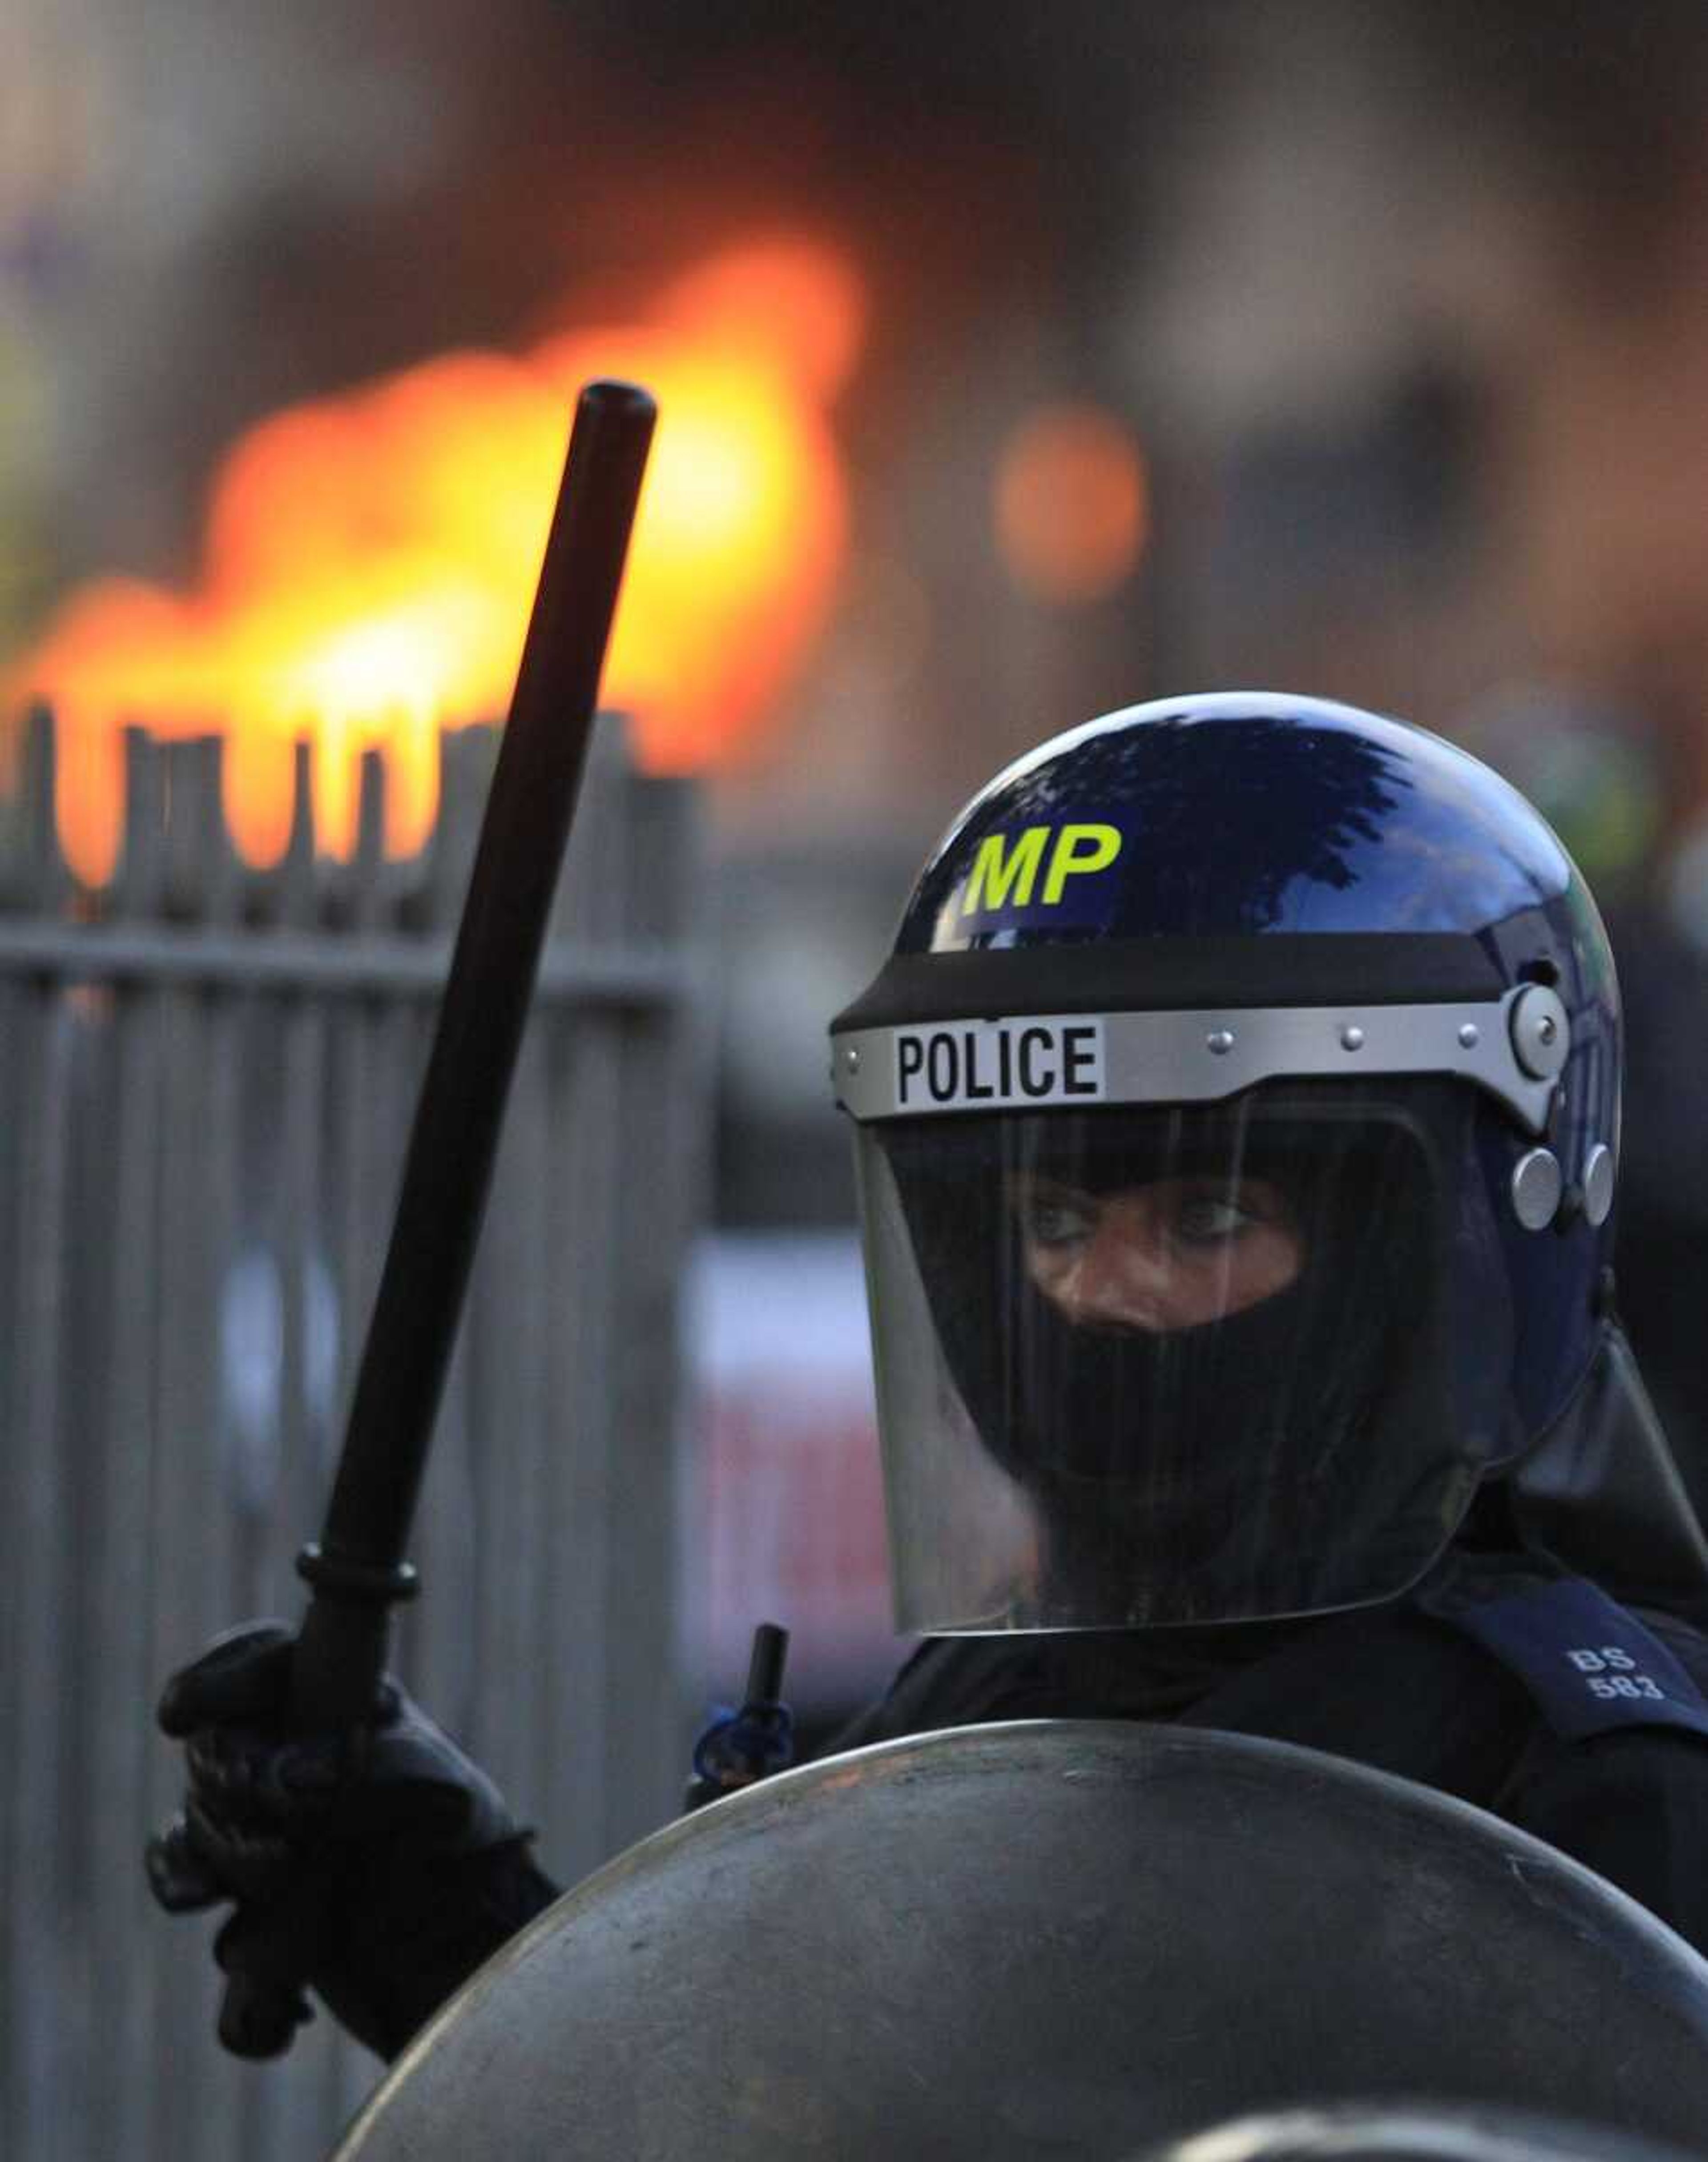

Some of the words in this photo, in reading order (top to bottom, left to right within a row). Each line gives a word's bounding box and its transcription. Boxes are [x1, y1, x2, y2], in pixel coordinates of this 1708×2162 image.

[963, 824, 1122, 916] MP
[898, 1027, 1097, 1104] POLICE
[1567, 1647, 1635, 1671] BS
